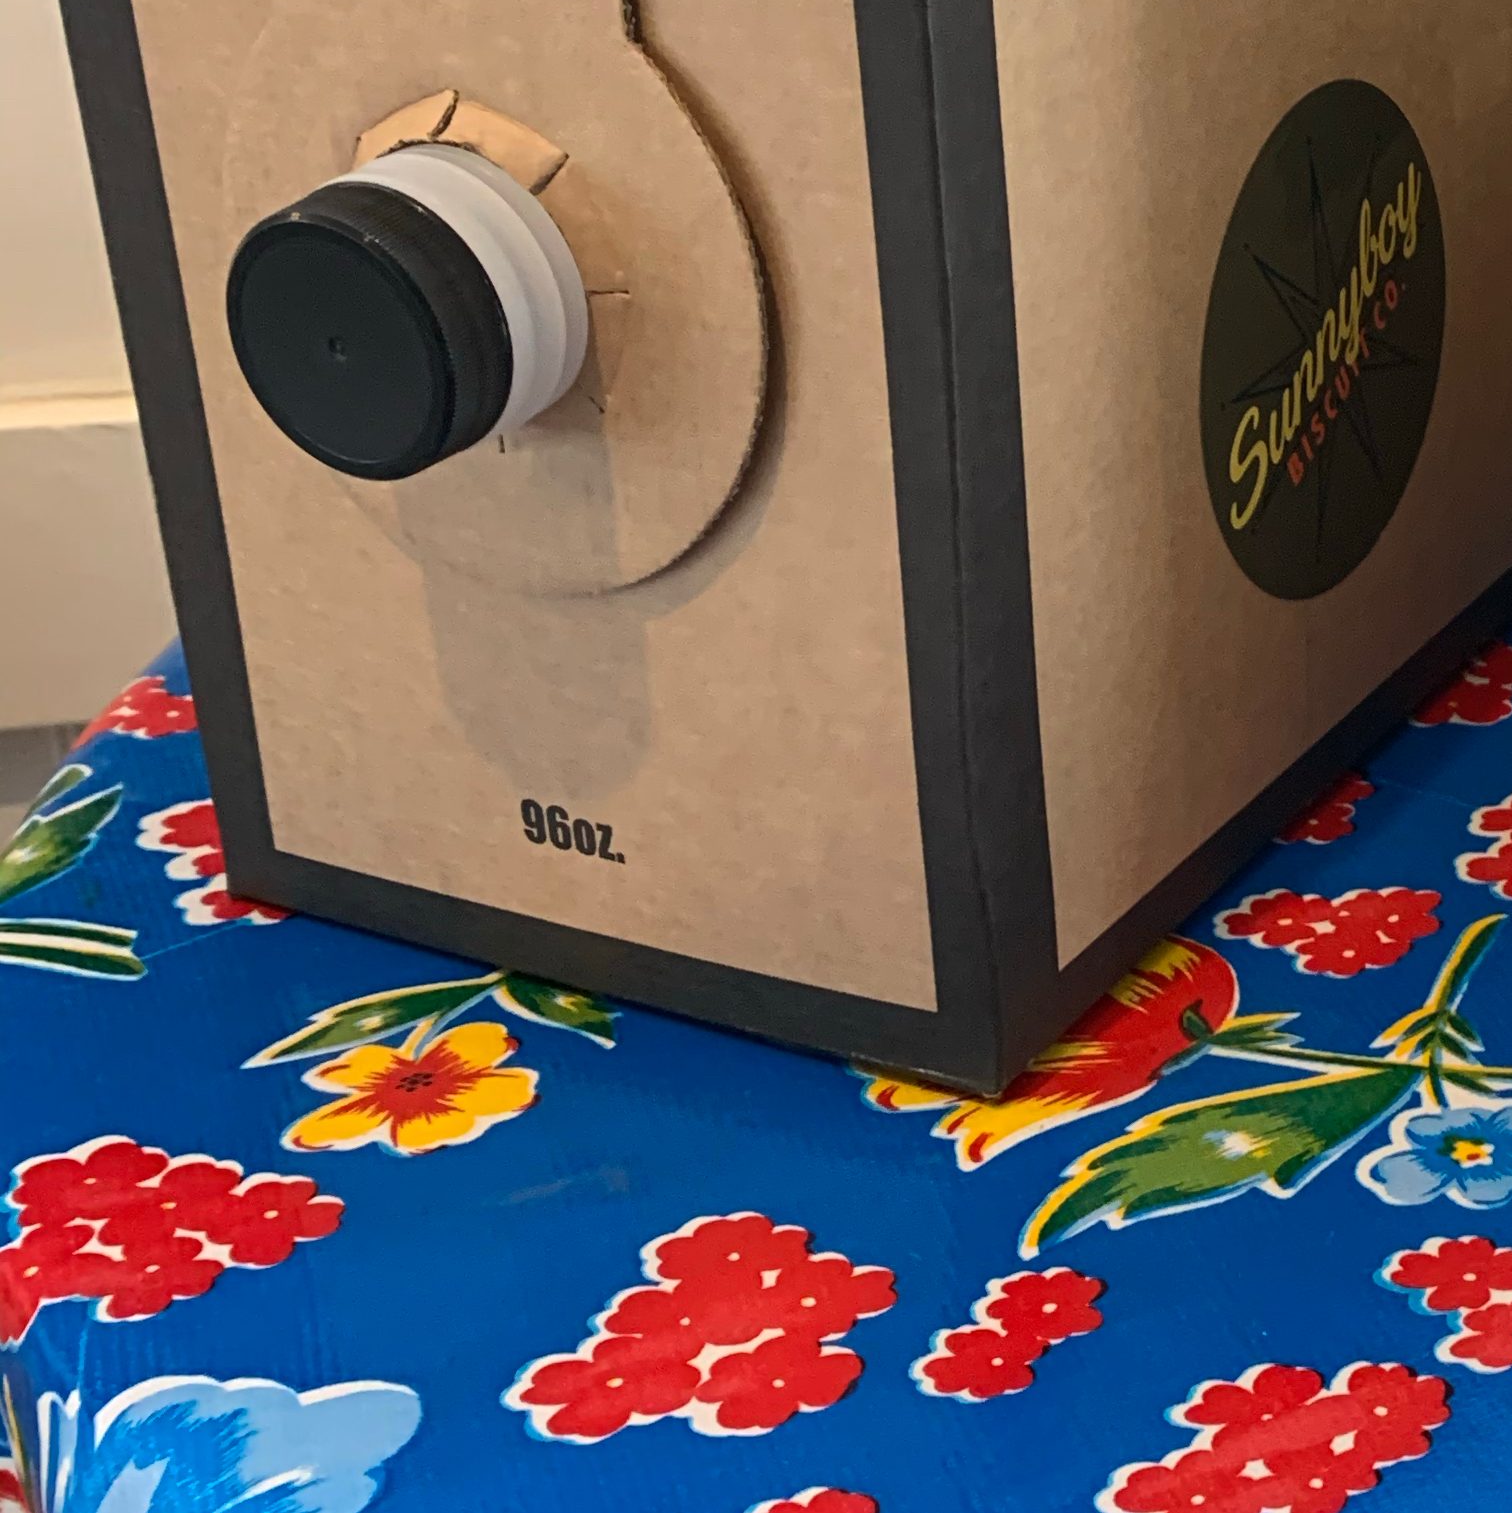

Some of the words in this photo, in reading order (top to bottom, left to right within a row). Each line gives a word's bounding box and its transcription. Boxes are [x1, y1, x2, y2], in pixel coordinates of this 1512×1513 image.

[1229, 161, 1422, 530] Sunnyboy
[1287, 327, 1371, 486] BISCUIT
[520, 798, 626, 865] 96oz.
